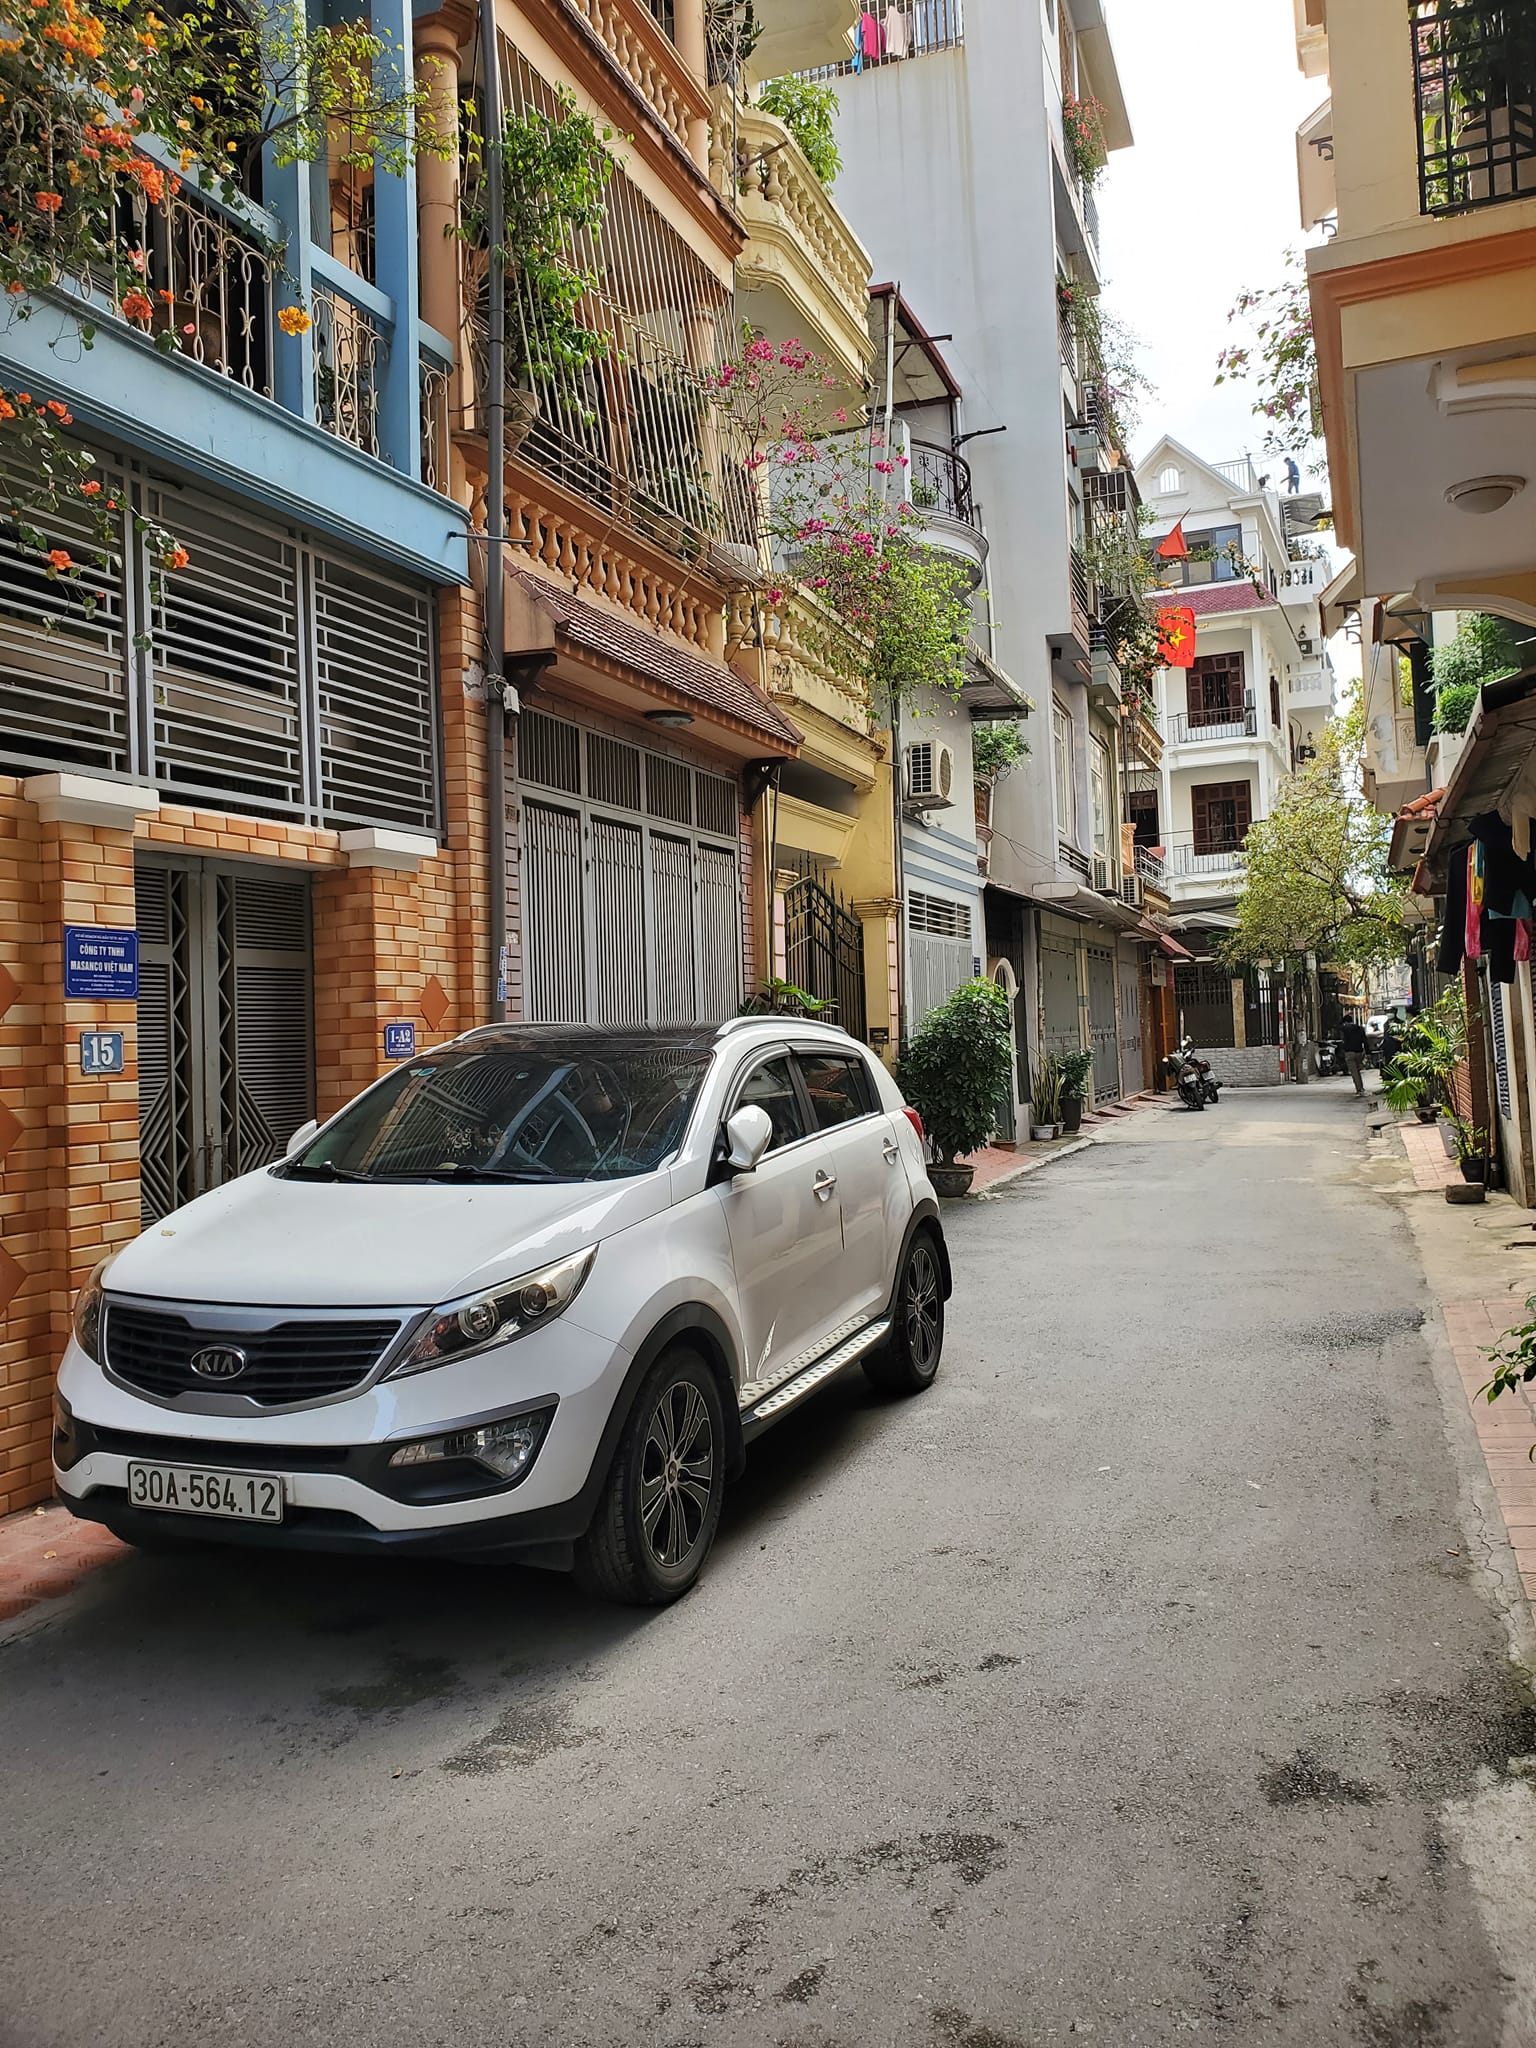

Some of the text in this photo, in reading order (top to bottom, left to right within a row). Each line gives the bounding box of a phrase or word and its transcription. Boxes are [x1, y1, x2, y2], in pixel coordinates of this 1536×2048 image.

[79, 943, 125, 957] CÔNG TY TNHH
[70, 960, 134, 974] MASANCO VIỆT NAM
[390, 1030, 411, 1043] 1-A2
[90, 1037, 114, 1066] 15
[199, 1353, 235, 1373] KIA
[133, 1468, 277, 1517] 30A-564.12
